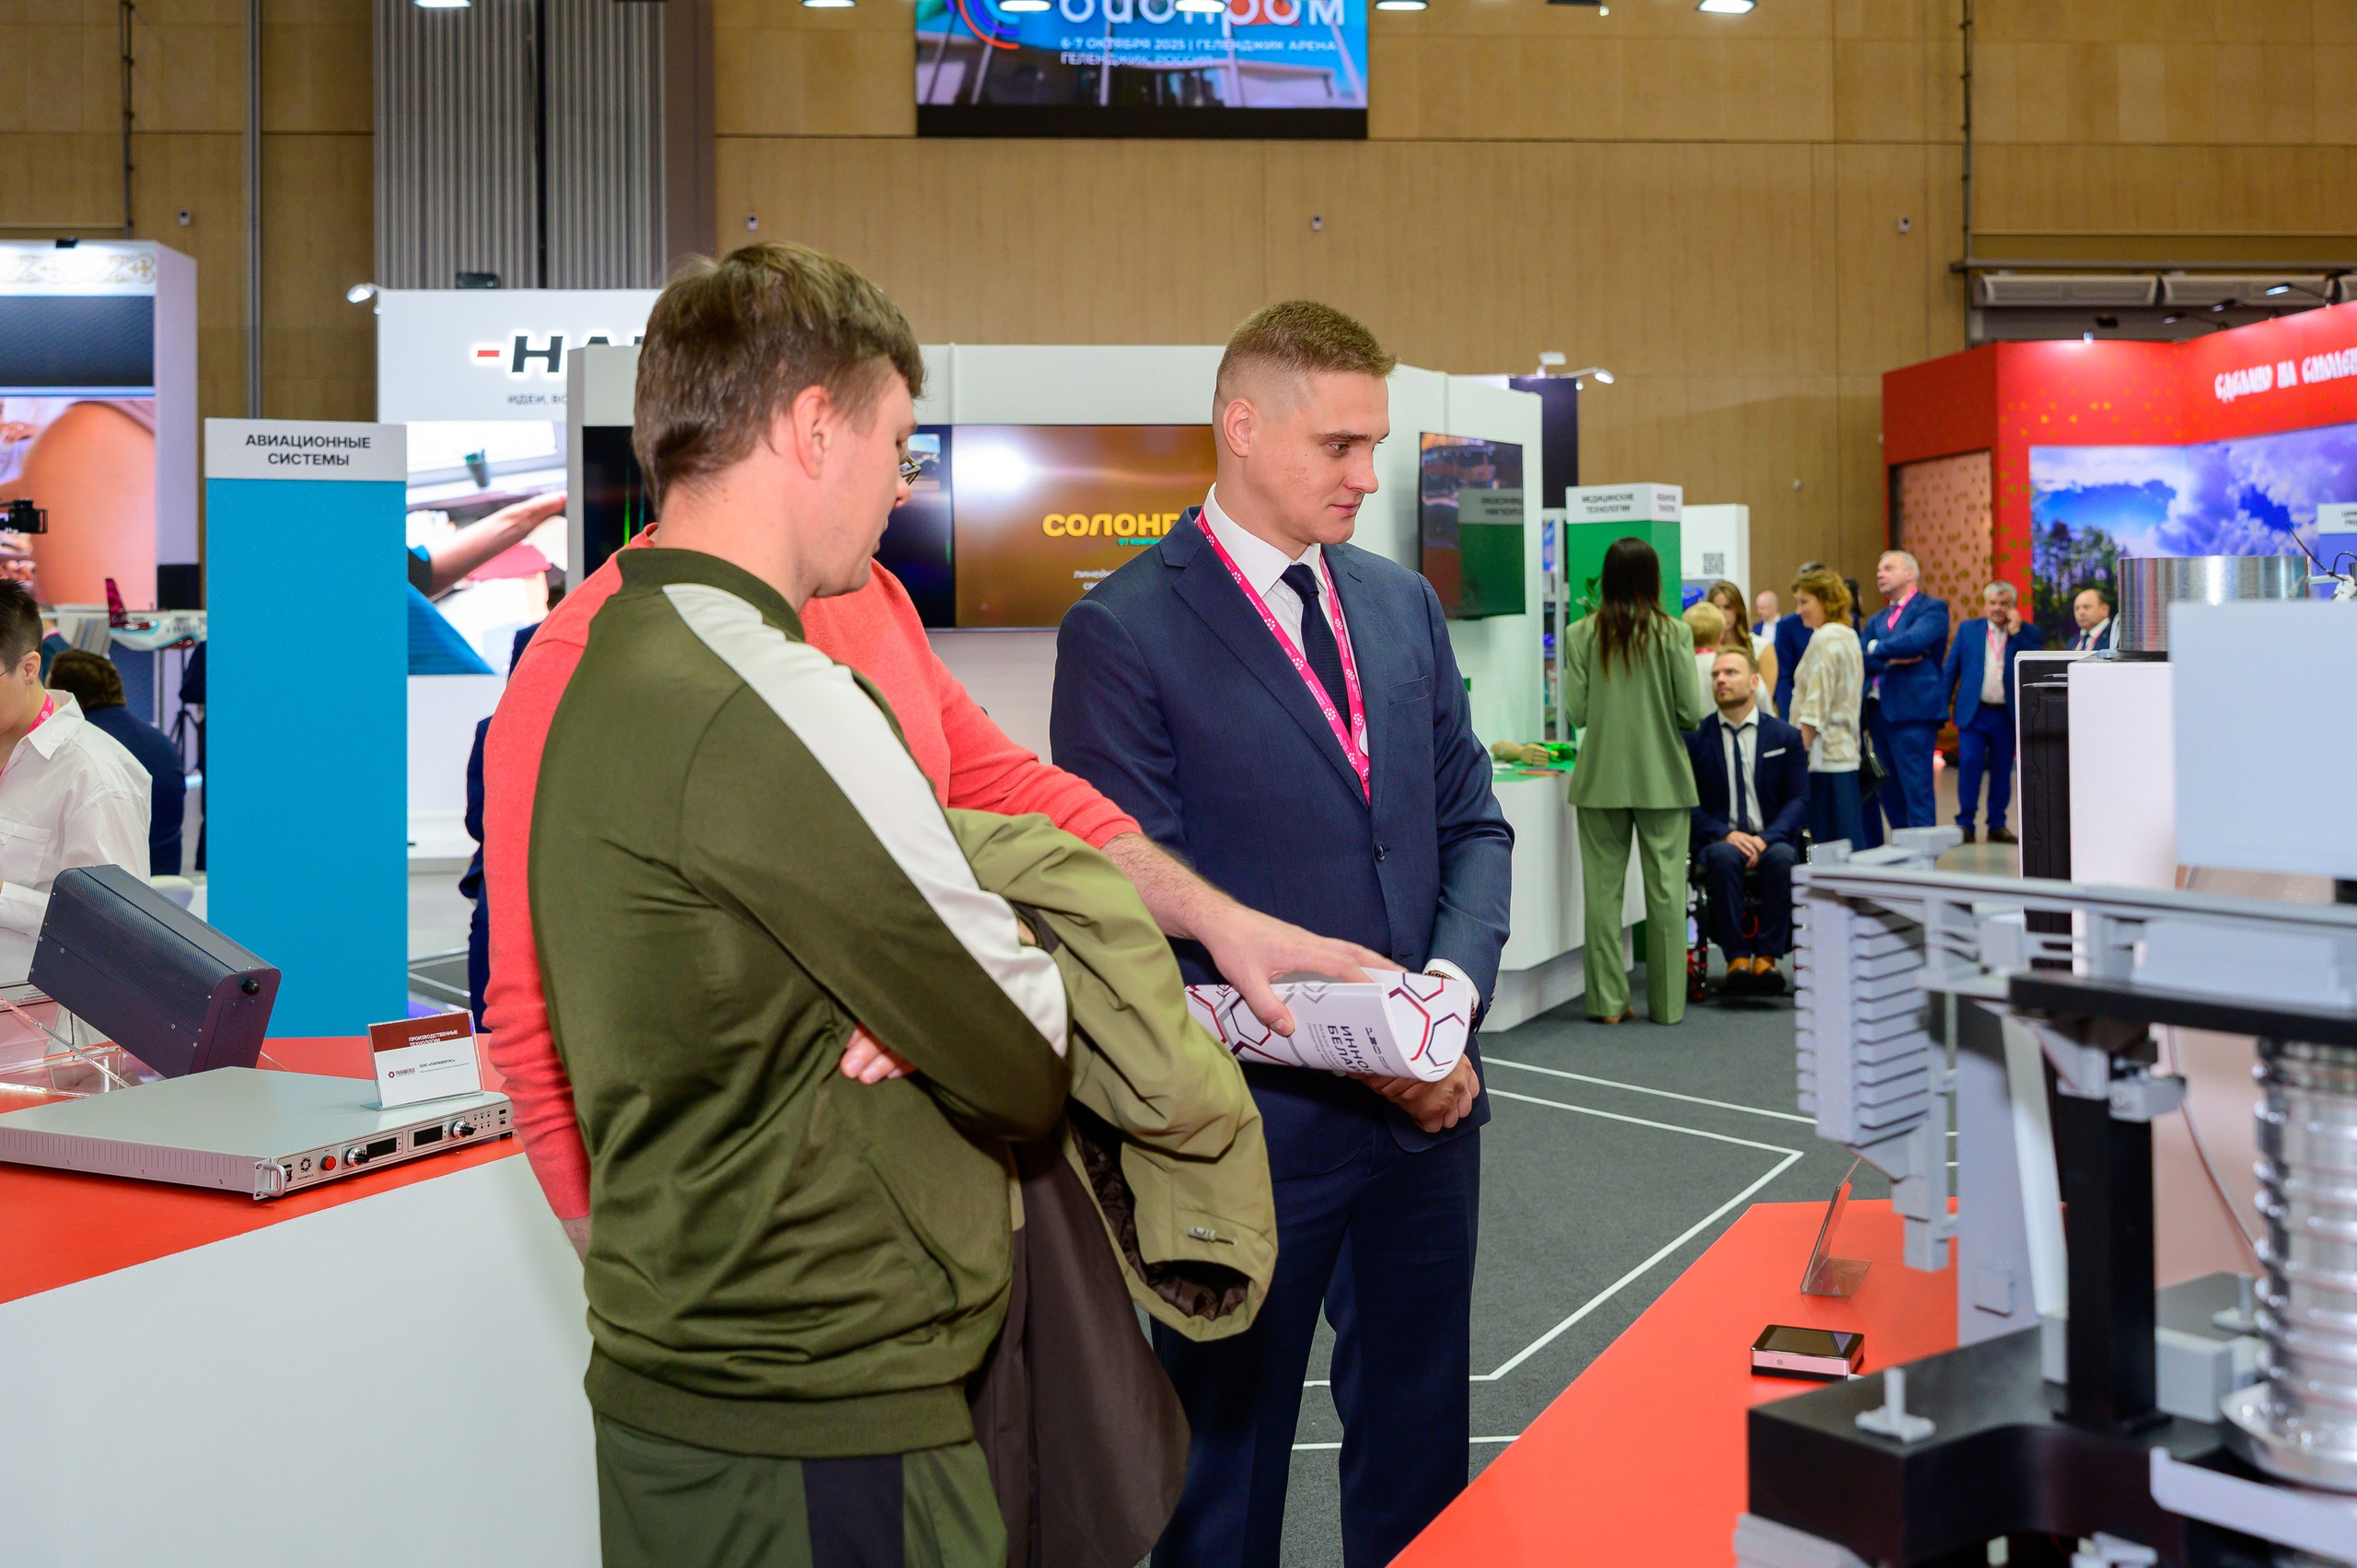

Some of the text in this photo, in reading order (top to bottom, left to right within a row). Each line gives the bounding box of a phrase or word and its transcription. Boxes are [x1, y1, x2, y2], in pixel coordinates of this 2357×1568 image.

[1154, 38, 1186, 51] 2025
[1289, 39, 1335, 51] АРЕНА
[2277, 359, 2298, 389] НА
[246, 435, 371, 449] АВИАЦИОННЫЕ
[268, 453, 350, 466] СИСТЕМЫ
[409, 1029, 459, 1042] ПРОИЗВОДСТВЕННЫЕ
